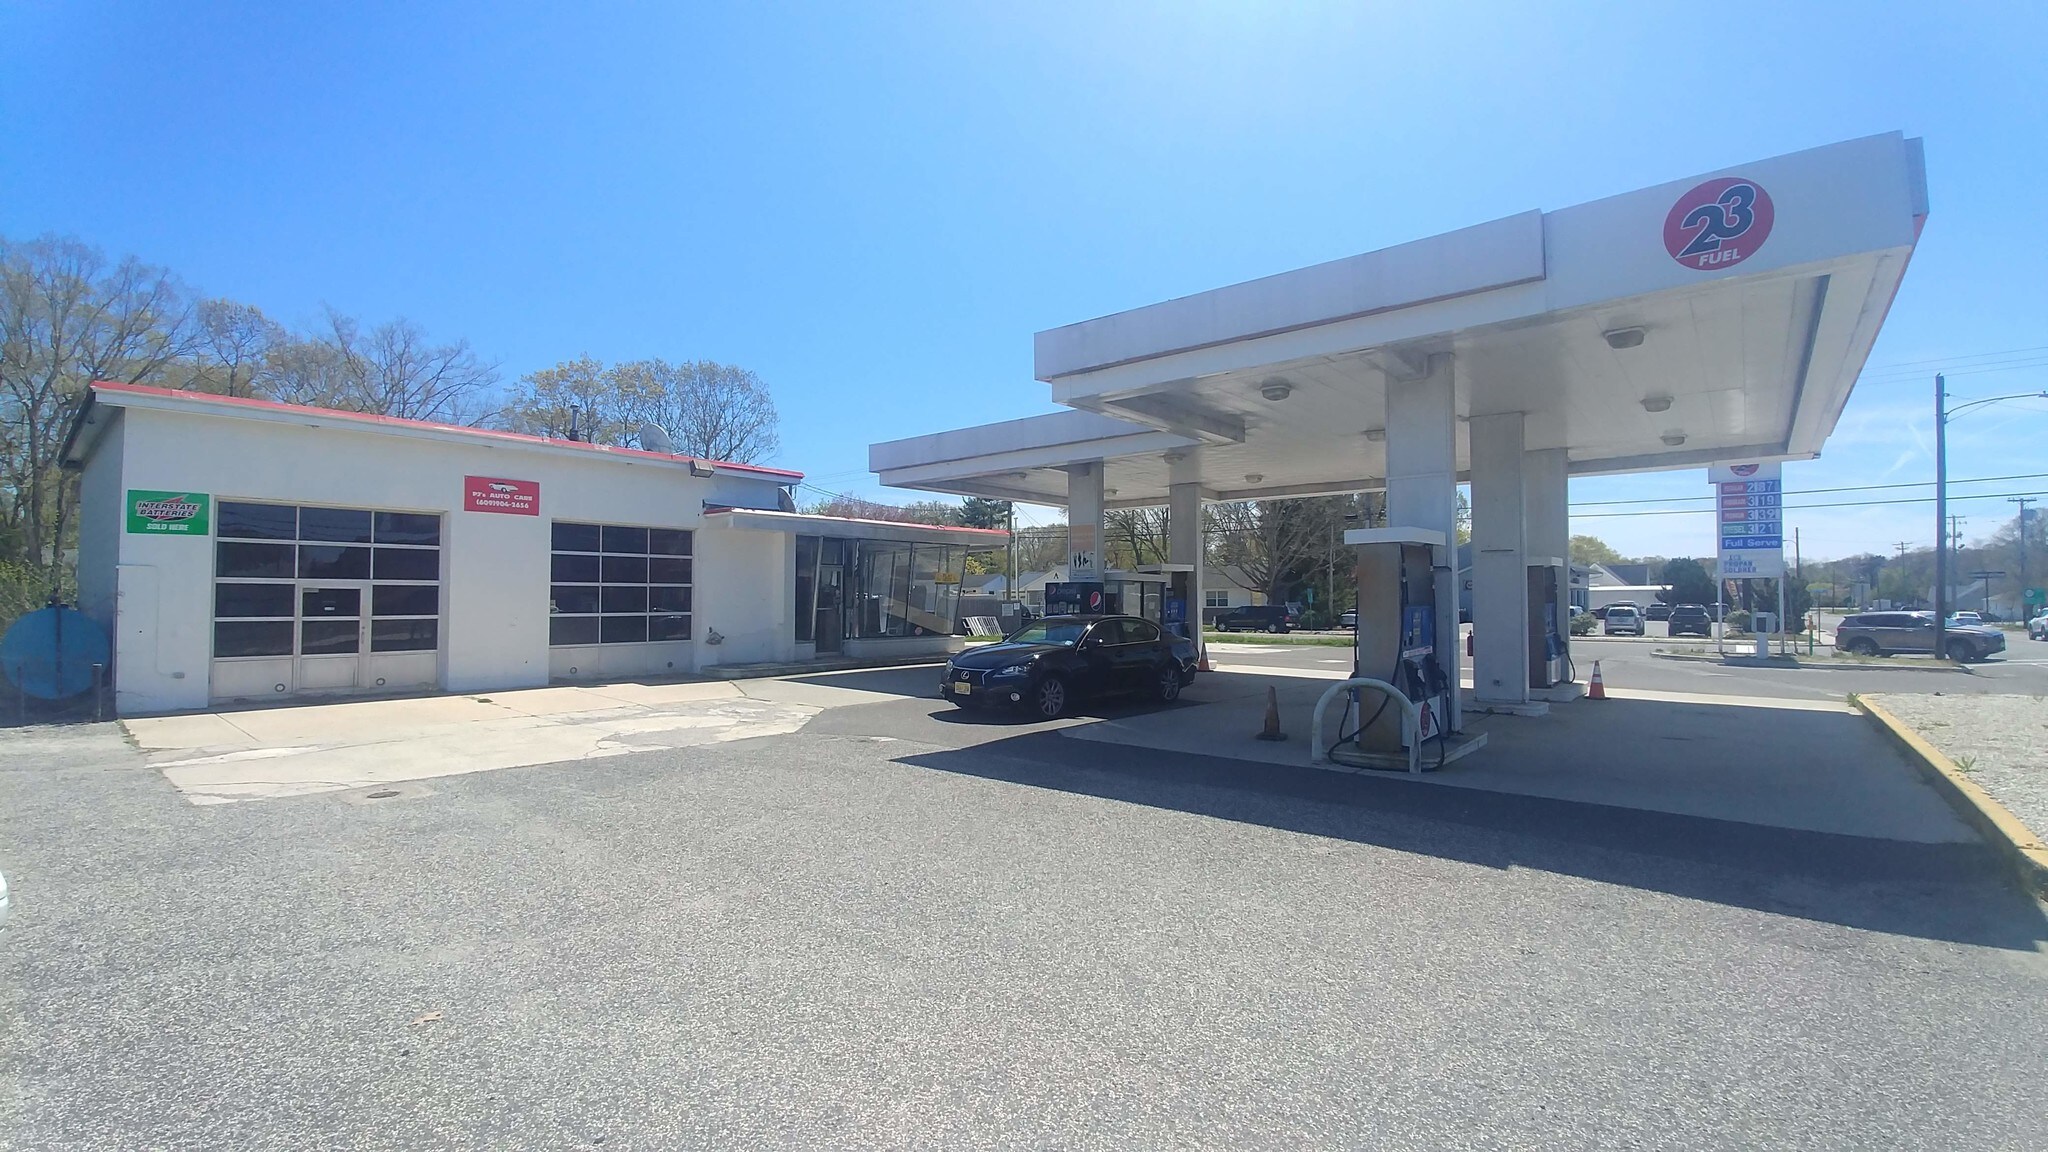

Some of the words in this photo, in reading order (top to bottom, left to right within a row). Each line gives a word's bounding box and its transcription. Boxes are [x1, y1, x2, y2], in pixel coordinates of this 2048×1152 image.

[1675, 183, 1757, 259] 23
[1698, 248, 1741, 266] FUEL
[138, 502, 198, 510] INTERSTATE
[1725, 539, 1743, 547] Full
[1747, 538, 1778, 547] Serve
